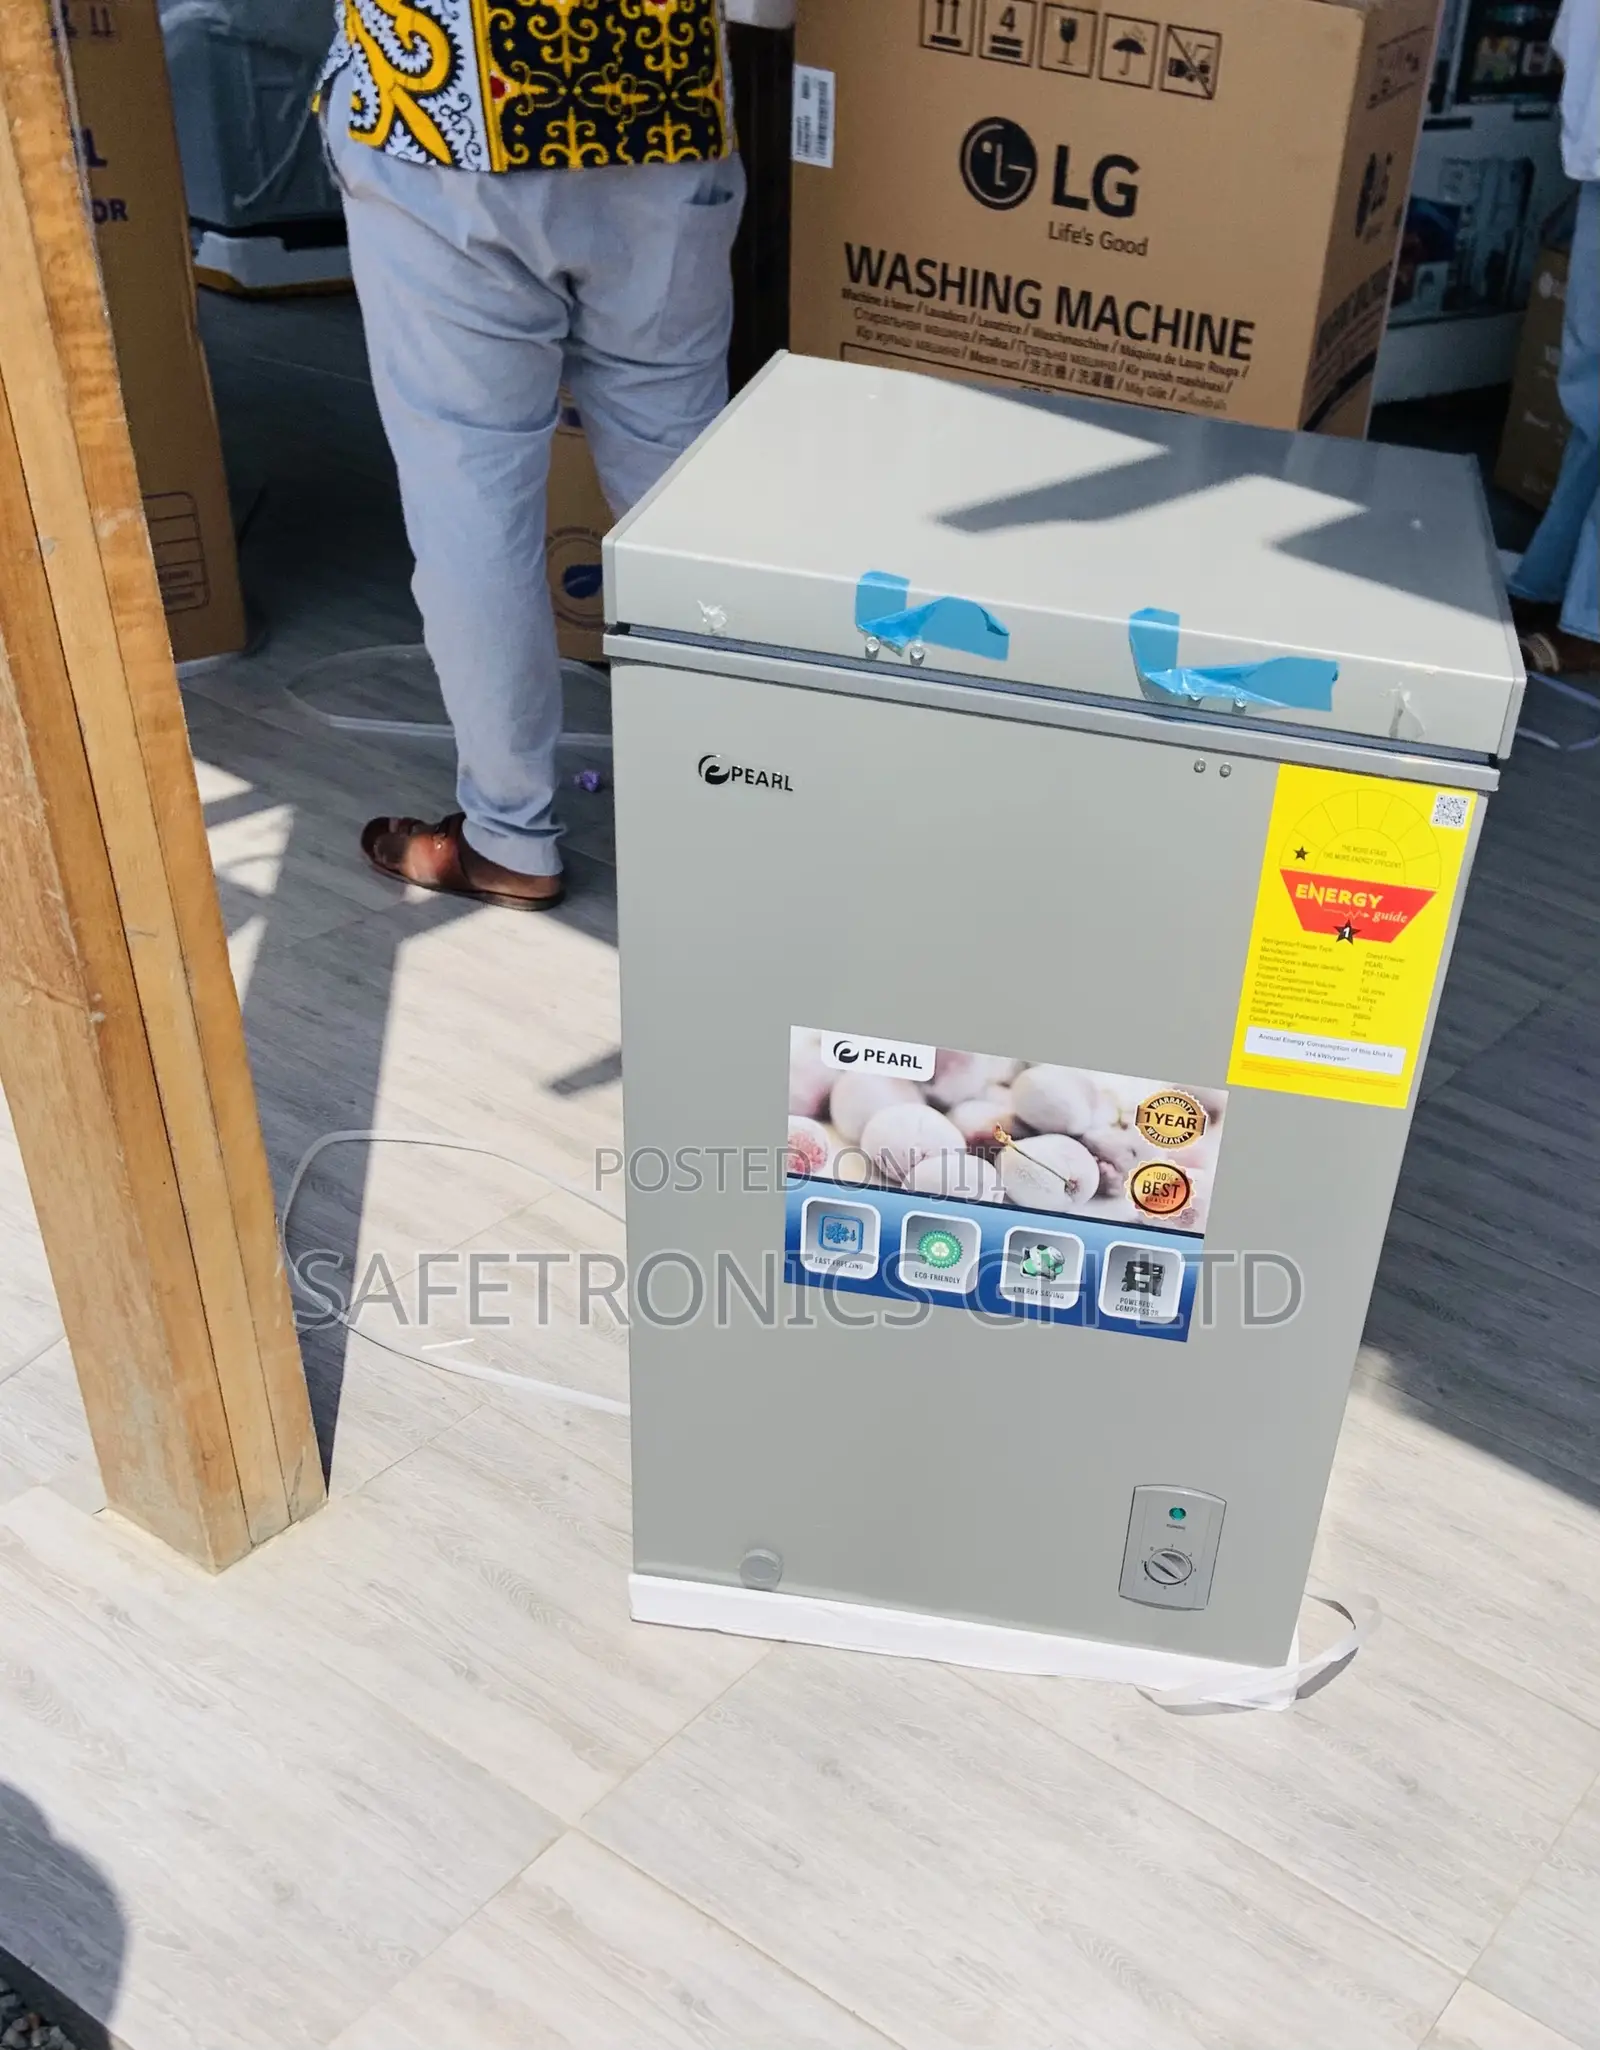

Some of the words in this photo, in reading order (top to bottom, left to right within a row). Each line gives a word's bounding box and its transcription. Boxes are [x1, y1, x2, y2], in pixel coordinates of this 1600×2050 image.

[1051, 145, 1140, 219] LG
[92, 197, 129, 224] OR
[1048, 221, 1094, 247] Life's
[1100, 232, 1148, 257] Good
[844, 242, 1042, 320] WASHING
[1054, 285, 1256, 361] MACHINE
[731, 766, 793, 792] PEARL
[1295, 881, 1384, 909] ENERGY
[1372, 911, 1408, 923] guide
[1344, 927, 1350, 938] 1
[1258, 1032, 1282, 1041] Annual
[1282, 1036, 1305, 1046] Energy
[1306, 1040, 1349, 1053] Consumption
[864, 1048, 923, 1070] PEARL
[1150, 1096, 1195, 1114] WARRANTY
[1144, 1111, 1151, 1123] 1
[1154, 1112, 1198, 1130] YEAR
[1146, 1127, 1191, 1144] WARRANTY
[1141, 1180, 1181, 1199] BEST
[914, 1271, 961, 1284] ECO-FRIENDLY
